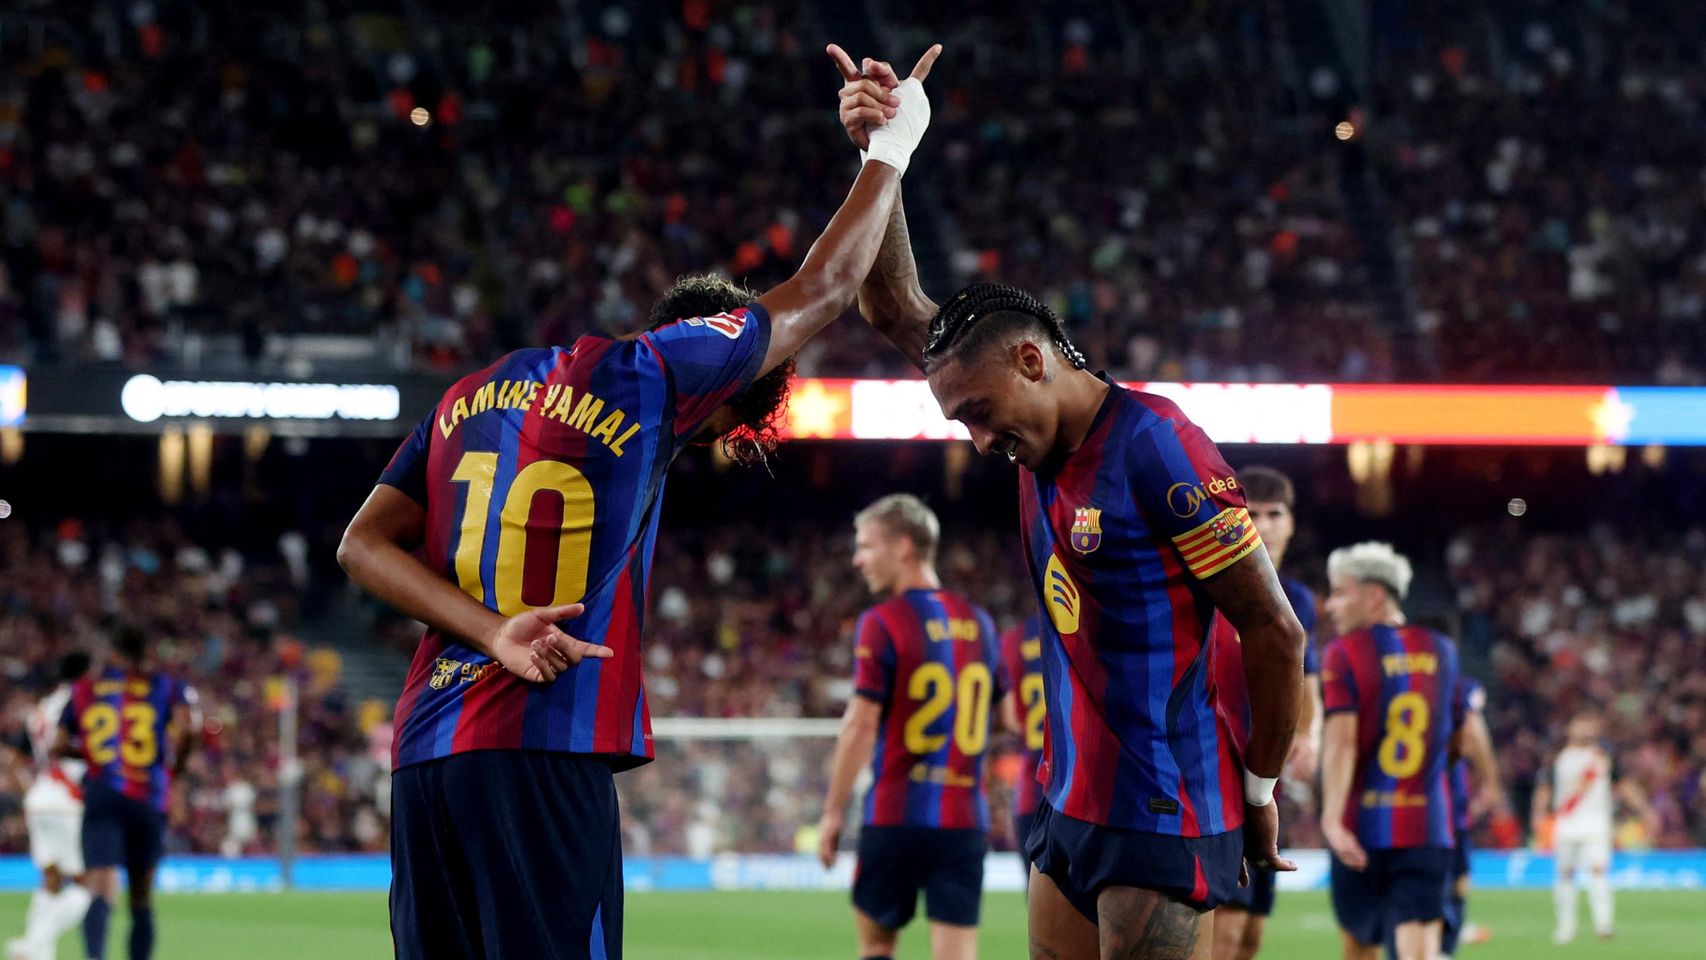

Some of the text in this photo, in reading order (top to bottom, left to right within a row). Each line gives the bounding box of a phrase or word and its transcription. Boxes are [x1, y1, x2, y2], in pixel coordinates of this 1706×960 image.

[439, 380, 544, 440] LAMINE
[540, 384, 641, 457] YAMAL
[451, 451, 595, 618] 10
[1167, 477, 1237, 518] Midea
[81, 702, 157, 768] 23
[904, 662, 992, 756] 20
[1378, 692, 1429, 778] 8
